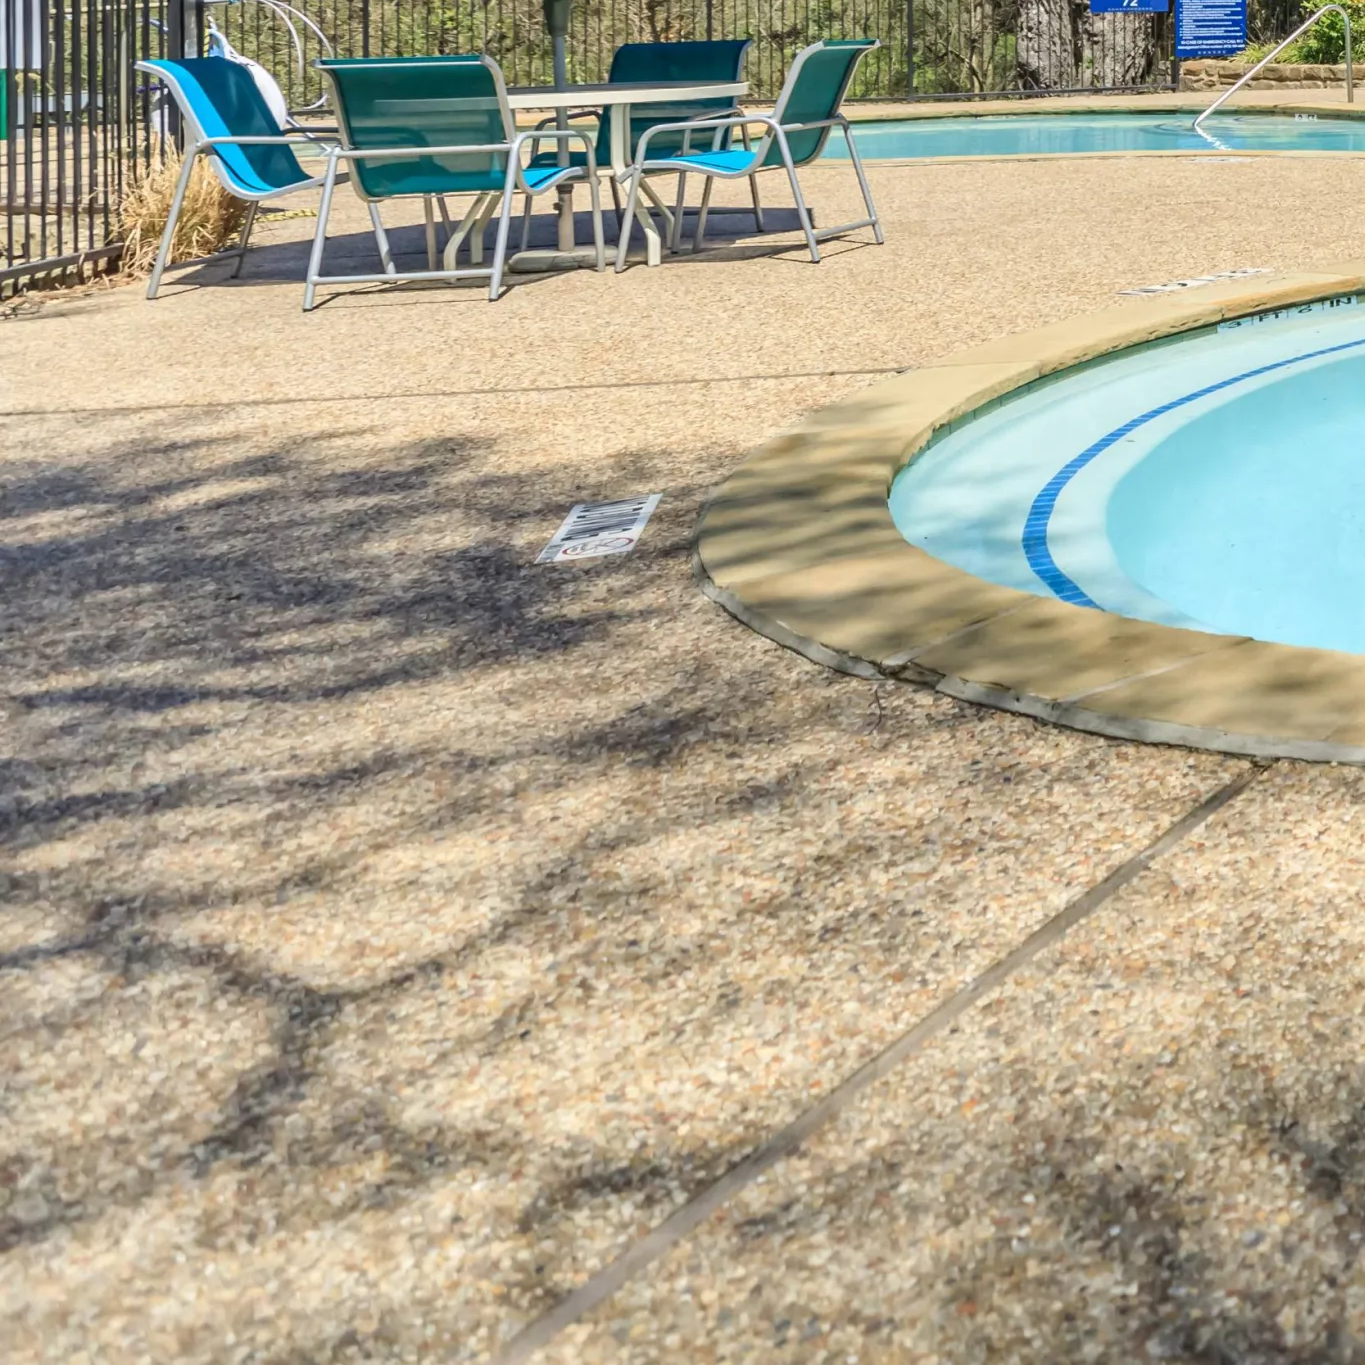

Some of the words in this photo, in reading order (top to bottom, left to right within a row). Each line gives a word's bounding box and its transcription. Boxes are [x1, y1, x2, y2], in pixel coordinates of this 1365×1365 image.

[1259, 311, 1283, 322] FT
[1298, 304, 1313, 314] 6
[1329, 297, 1352, 308] IN
